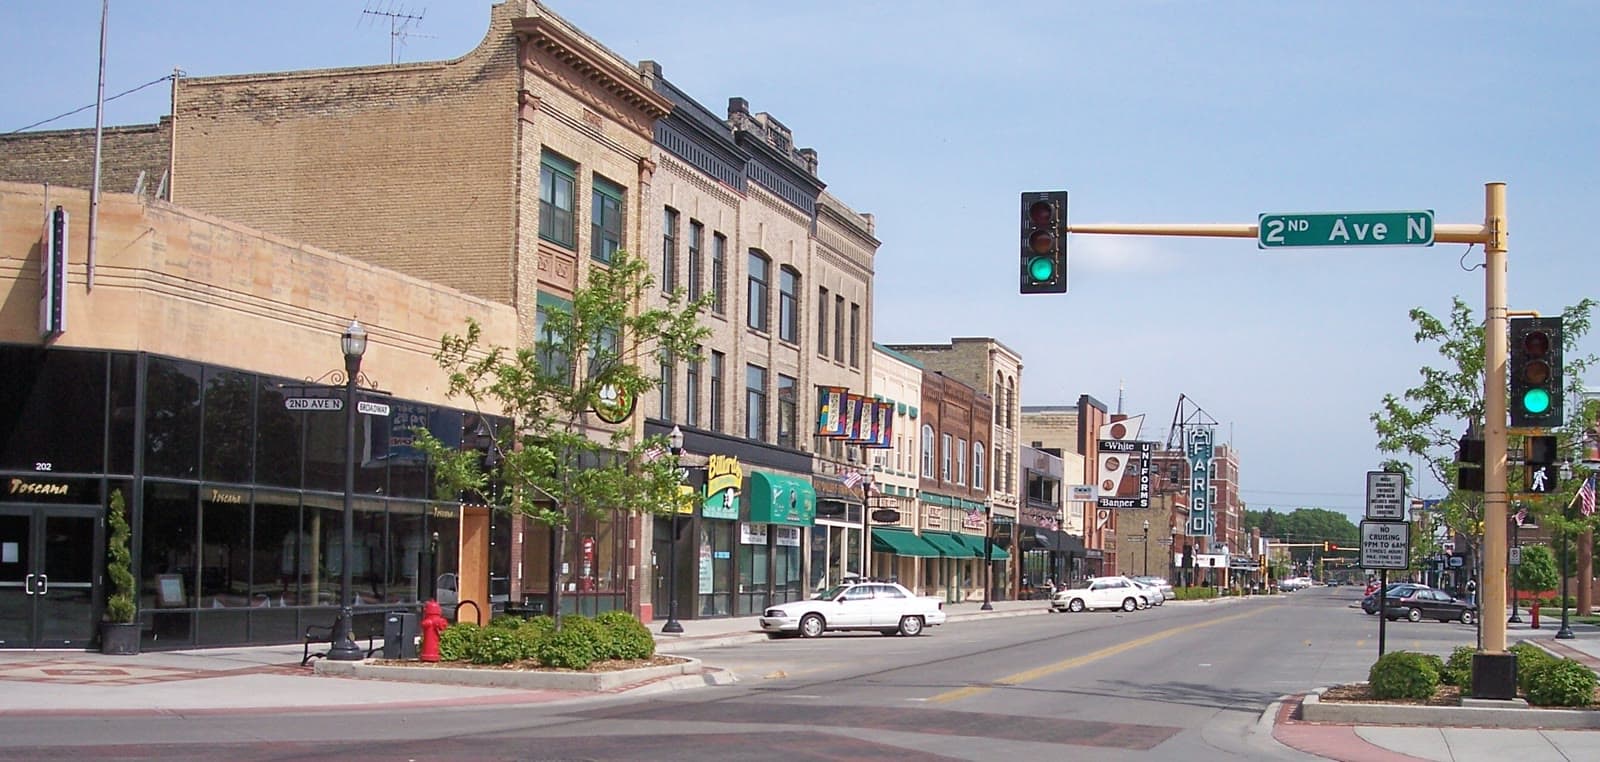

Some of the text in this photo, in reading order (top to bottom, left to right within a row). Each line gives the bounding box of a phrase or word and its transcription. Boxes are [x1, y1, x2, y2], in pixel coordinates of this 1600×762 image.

[1266, 217, 1426, 242] 2ND Ave N
[289, 399, 340, 409] 2ND AVE N
[359, 402, 388, 414] BROADWAY
[1105, 441, 1135, 450] White
[35, 462, 53, 471] 202
[1140, 444, 1150, 507] UNIFORMS
[10, 478, 69, 495] Toscana
[1192, 441, 1206, 531] FARGO
[1100, 498, 1135, 507] Banner
